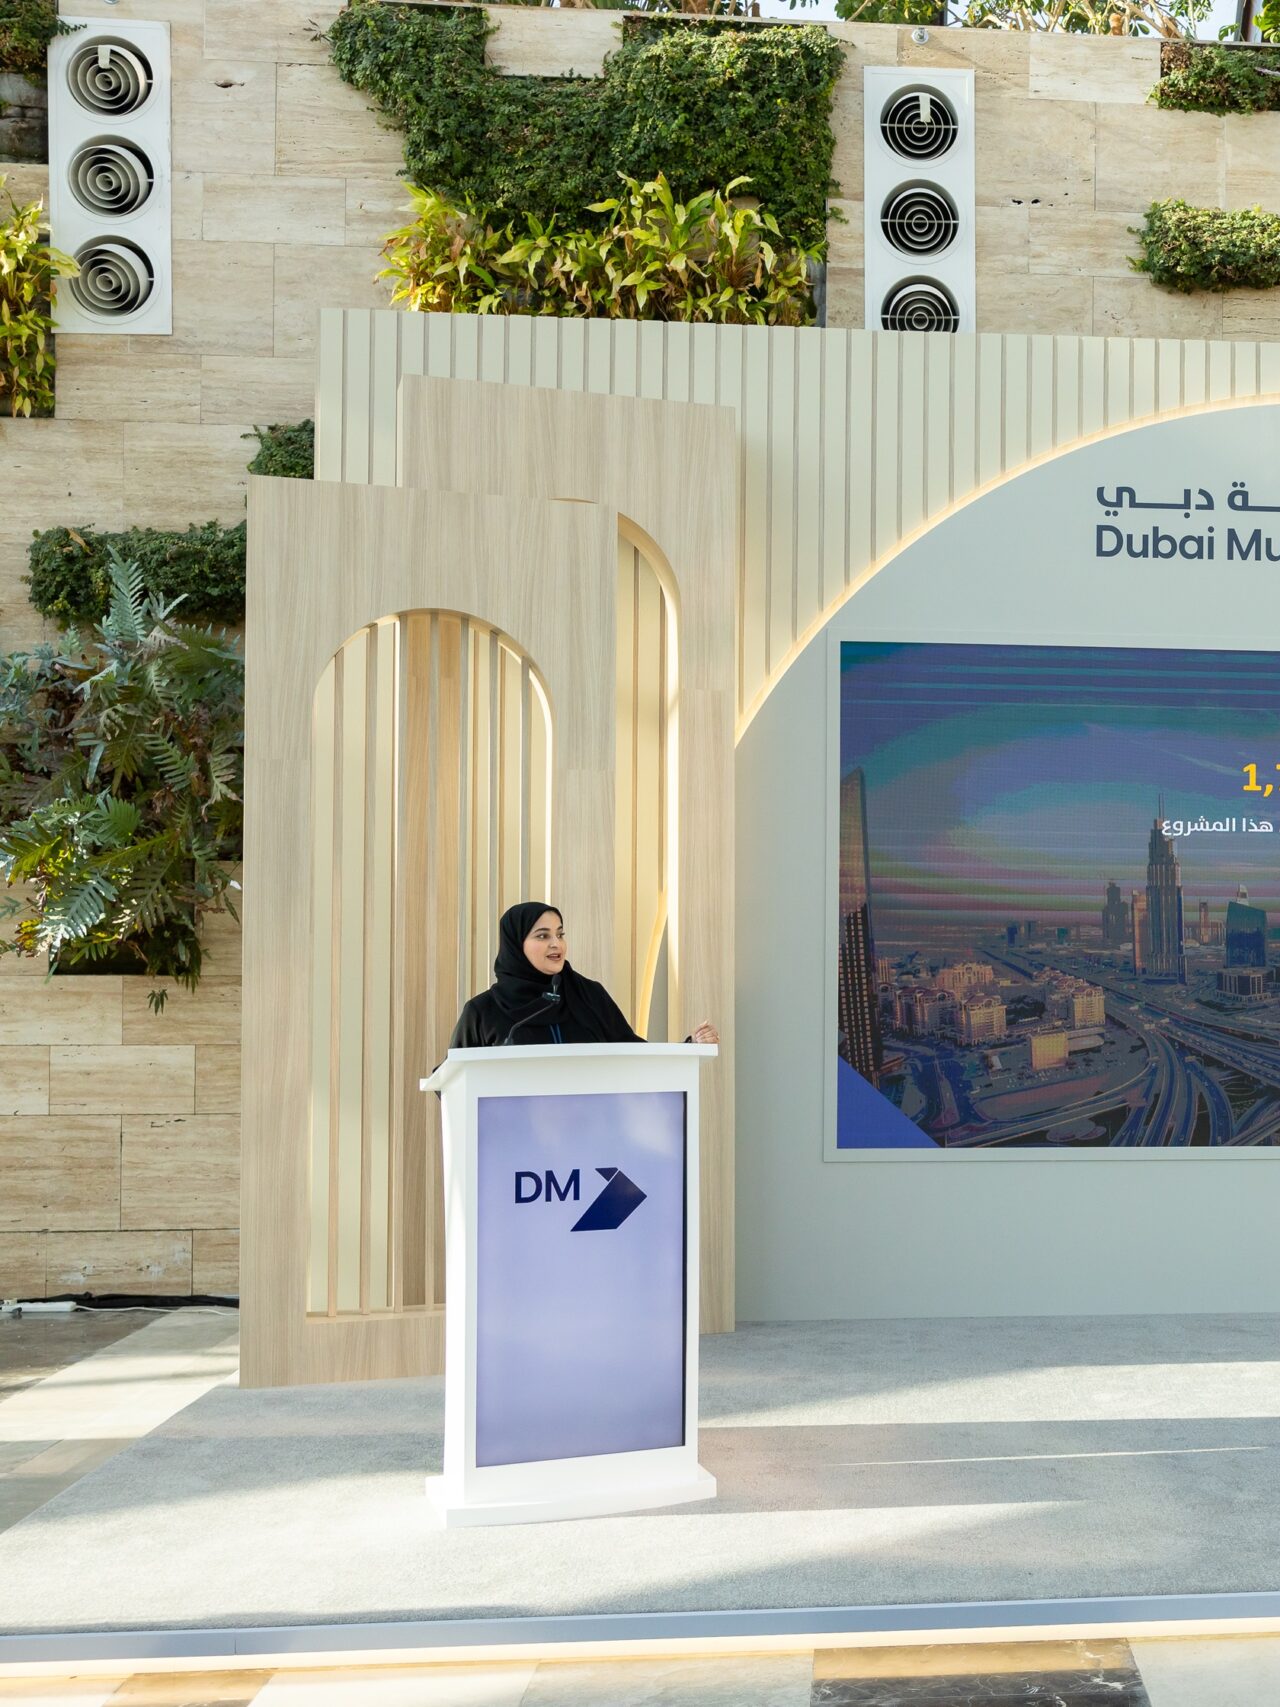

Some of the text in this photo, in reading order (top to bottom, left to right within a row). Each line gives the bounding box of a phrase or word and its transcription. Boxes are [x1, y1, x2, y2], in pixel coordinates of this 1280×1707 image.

[1096, 485, 1215, 519] دبي
[1095, 523, 1215, 561] Dubai
[1161, 815, 1236, 836] المشروع
[1242, 817, 1274, 833] هذا
[514, 1168, 580, 1205] DM
